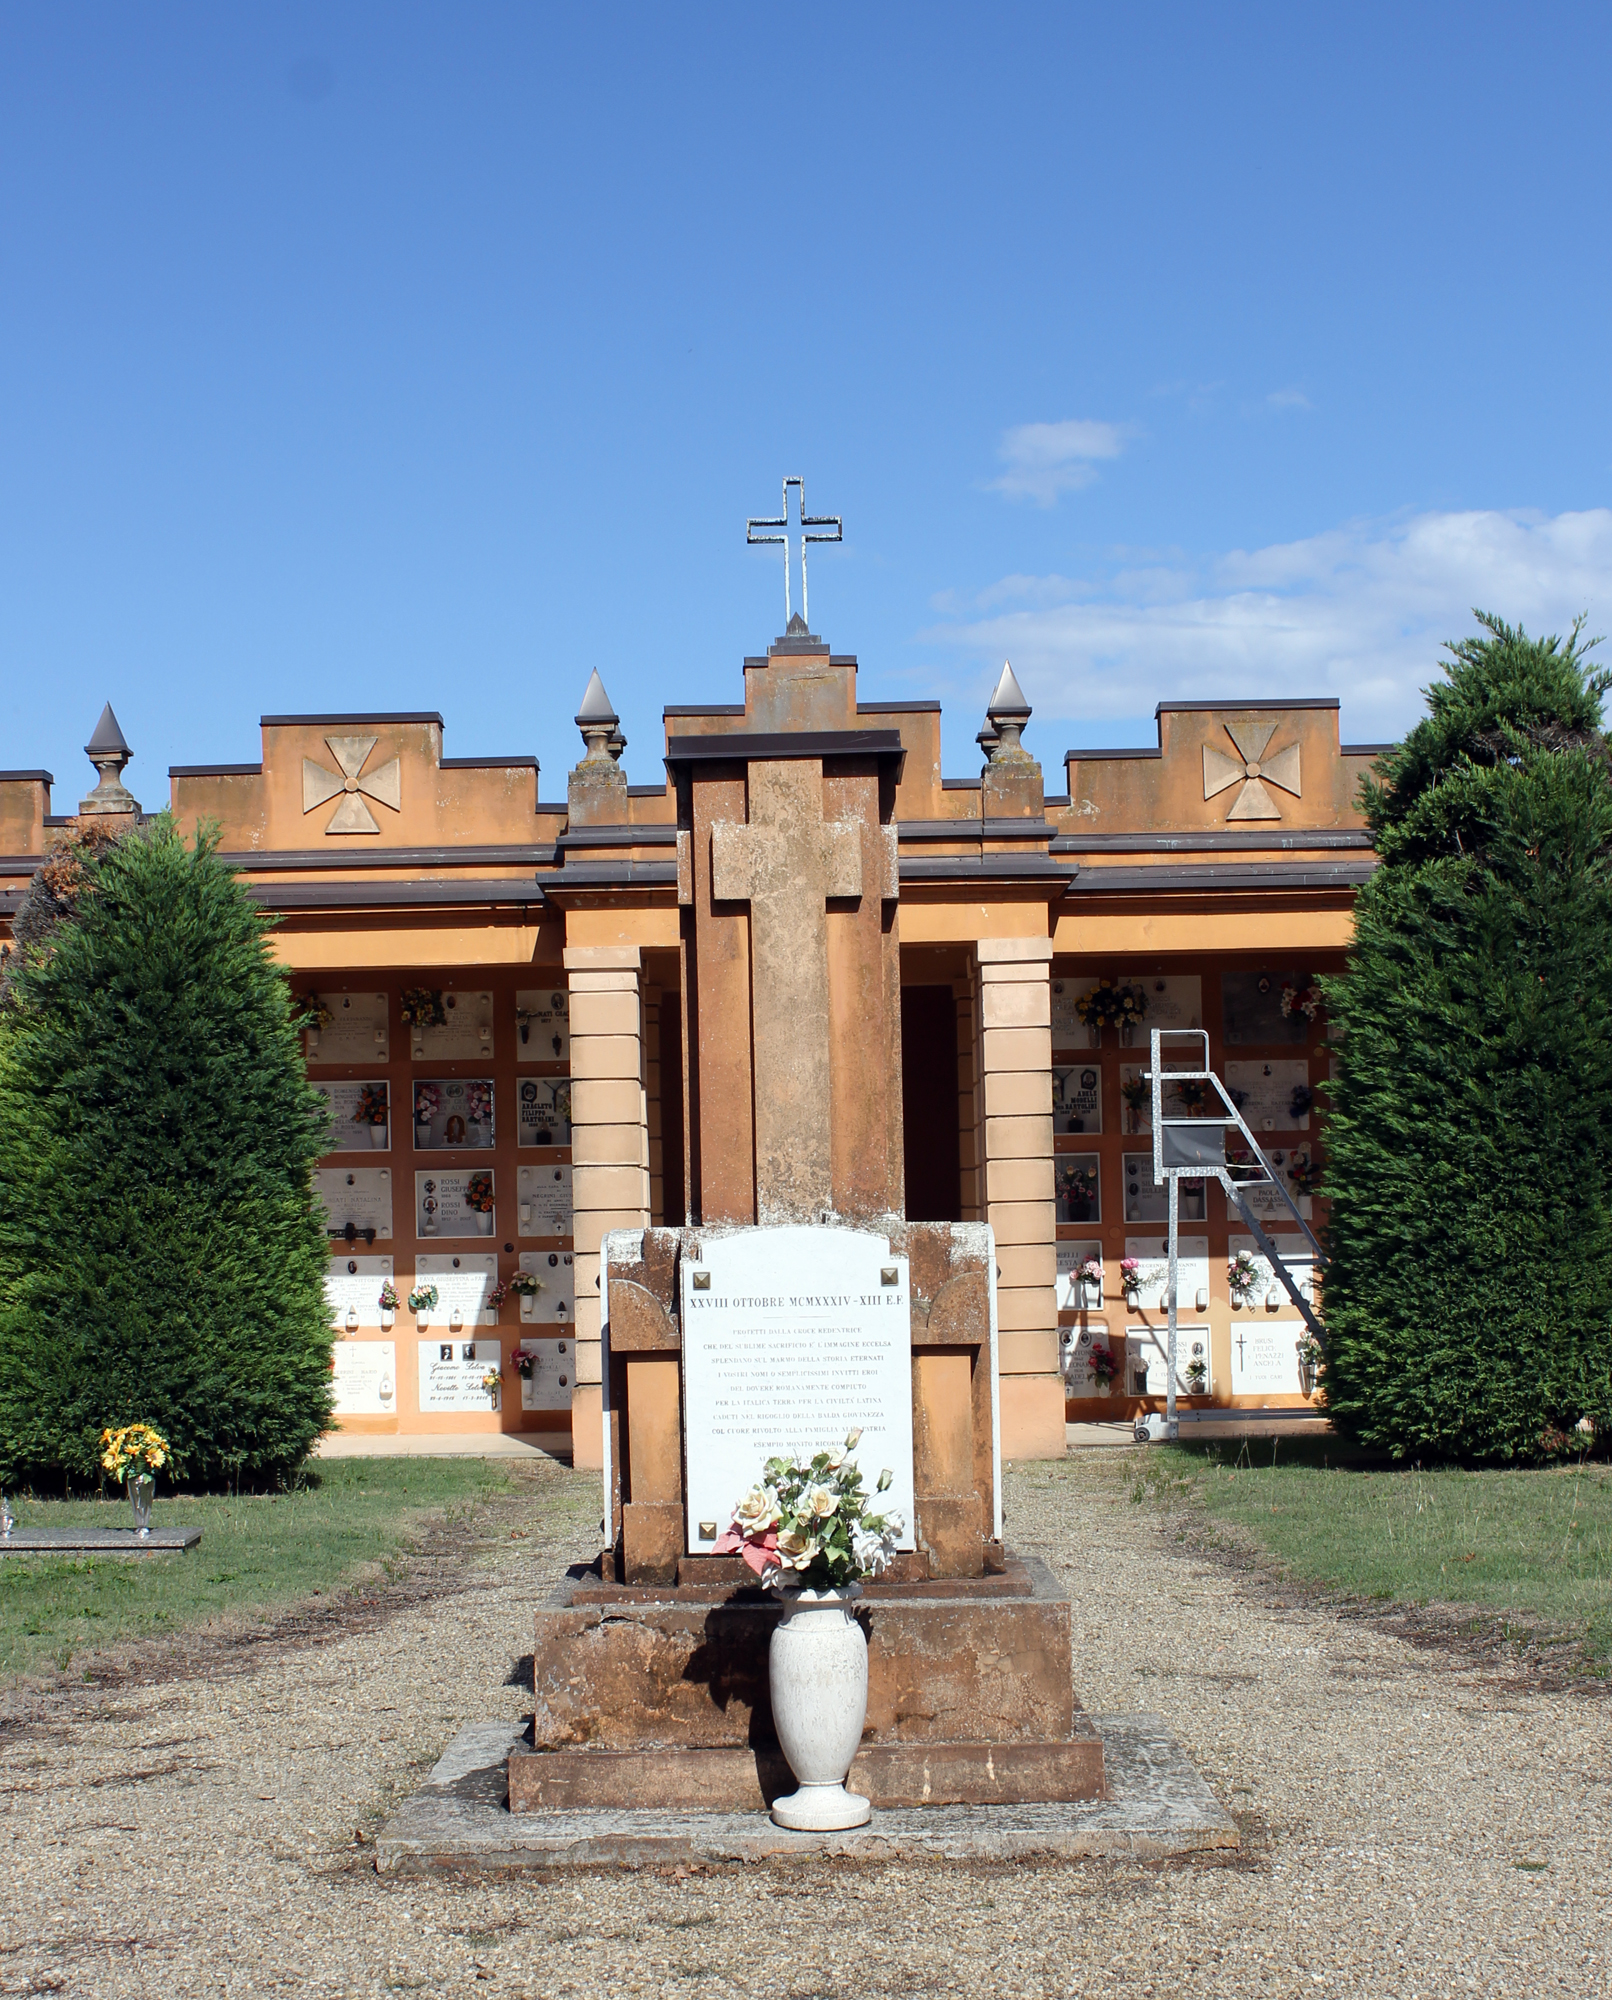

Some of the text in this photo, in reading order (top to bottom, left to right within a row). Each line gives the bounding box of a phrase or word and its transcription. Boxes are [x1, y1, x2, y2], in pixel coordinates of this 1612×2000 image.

[690, 1298, 729, 1309] XXVIII
[732, 1297, 785, 1308] OTTOBRE
[886, 1294, 904, 1306] E.F.
[1254, 1337, 1274, 1345] BRUSI
[1253, 1359, 1282, 1367] ANGELA
[429, 1362, 460, 1375] Giacomo
